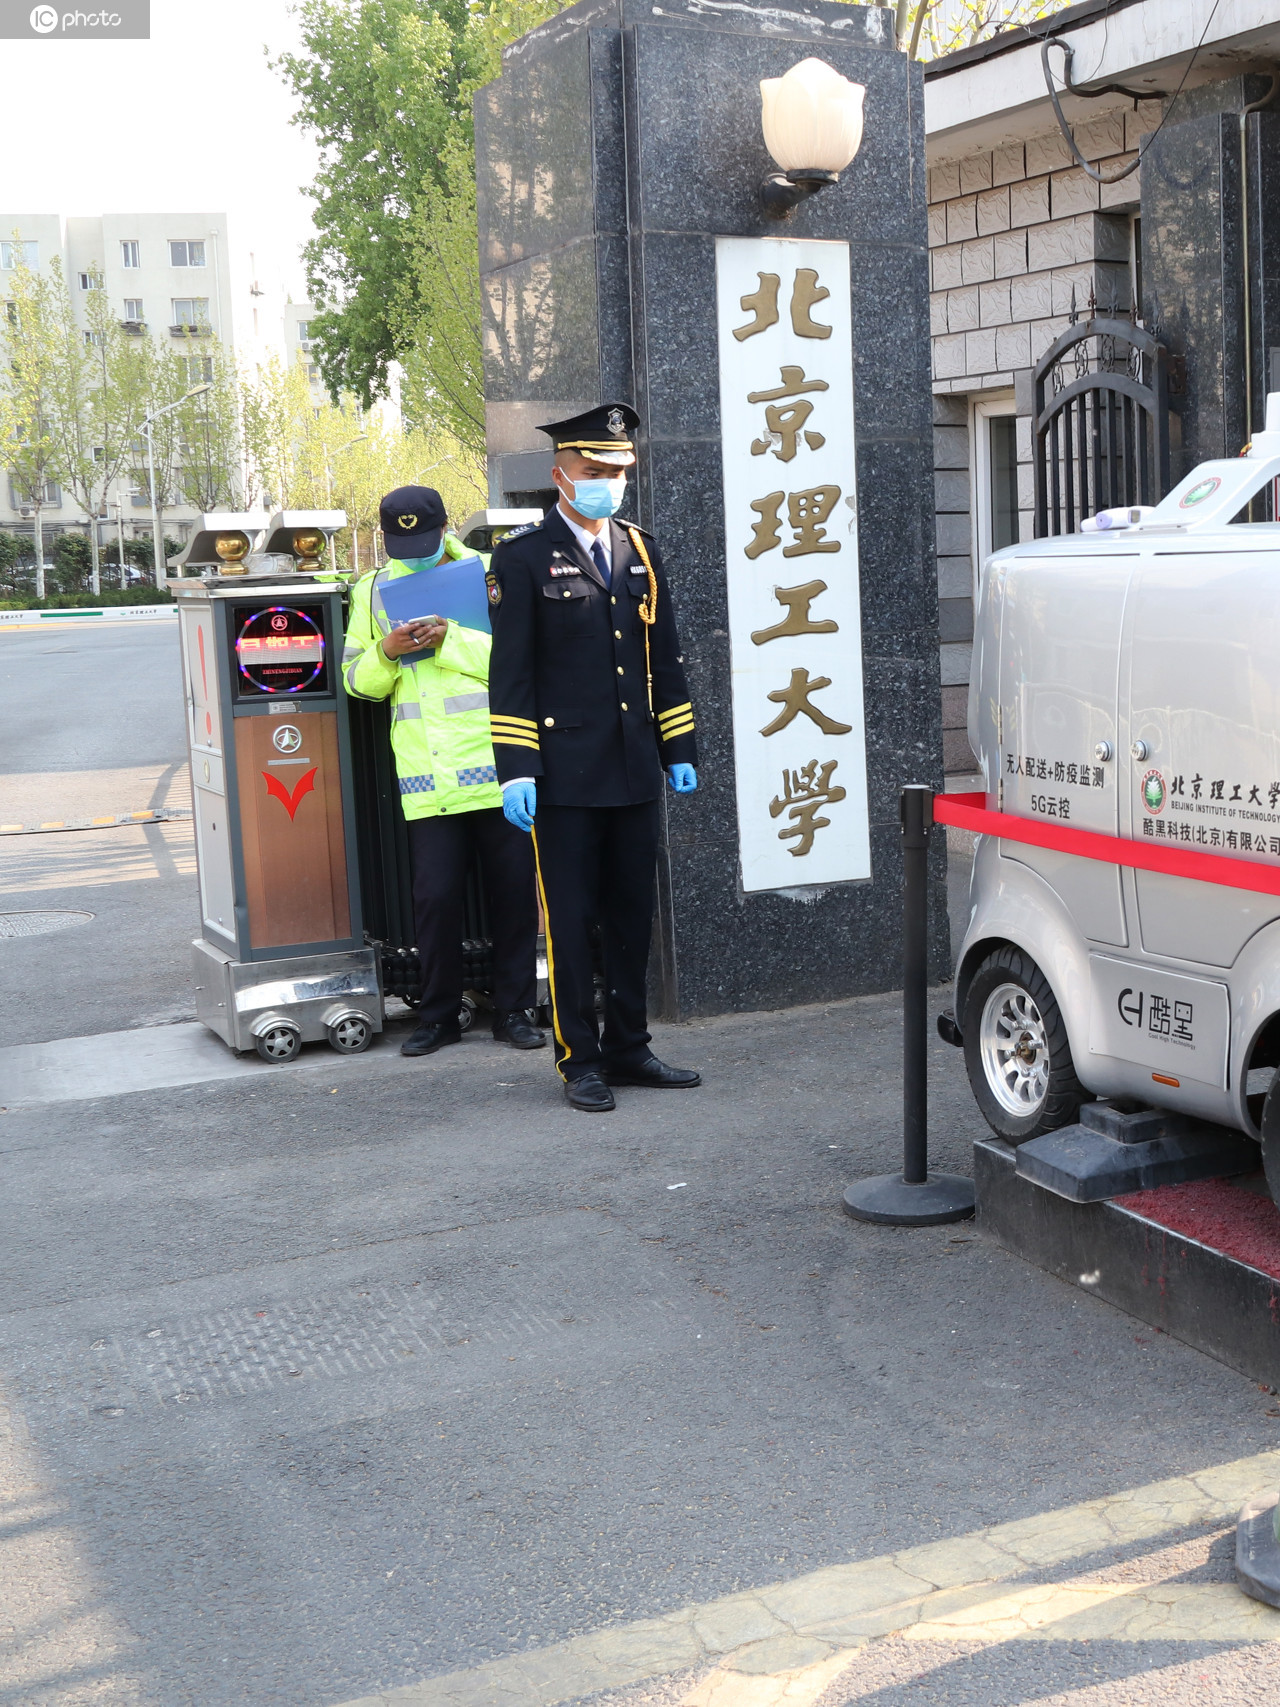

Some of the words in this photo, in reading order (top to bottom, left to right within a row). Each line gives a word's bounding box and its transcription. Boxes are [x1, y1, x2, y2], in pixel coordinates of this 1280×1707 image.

[1007, 754, 1105, 788] 无人配送+防疫监测
[1031, 794, 1070, 819] 5G云控
[1171, 800, 1194, 812] BEIJING
[1195, 804, 1227, 817] INSTITUTE
[1228, 808, 1237, 818] OF
[1238, 810, 1280, 823] TECHNOLOGY
[1143, 817, 1280, 856] 酷黑科技(北京)有限公司
[1160, 1034, 1170, 1043] High
